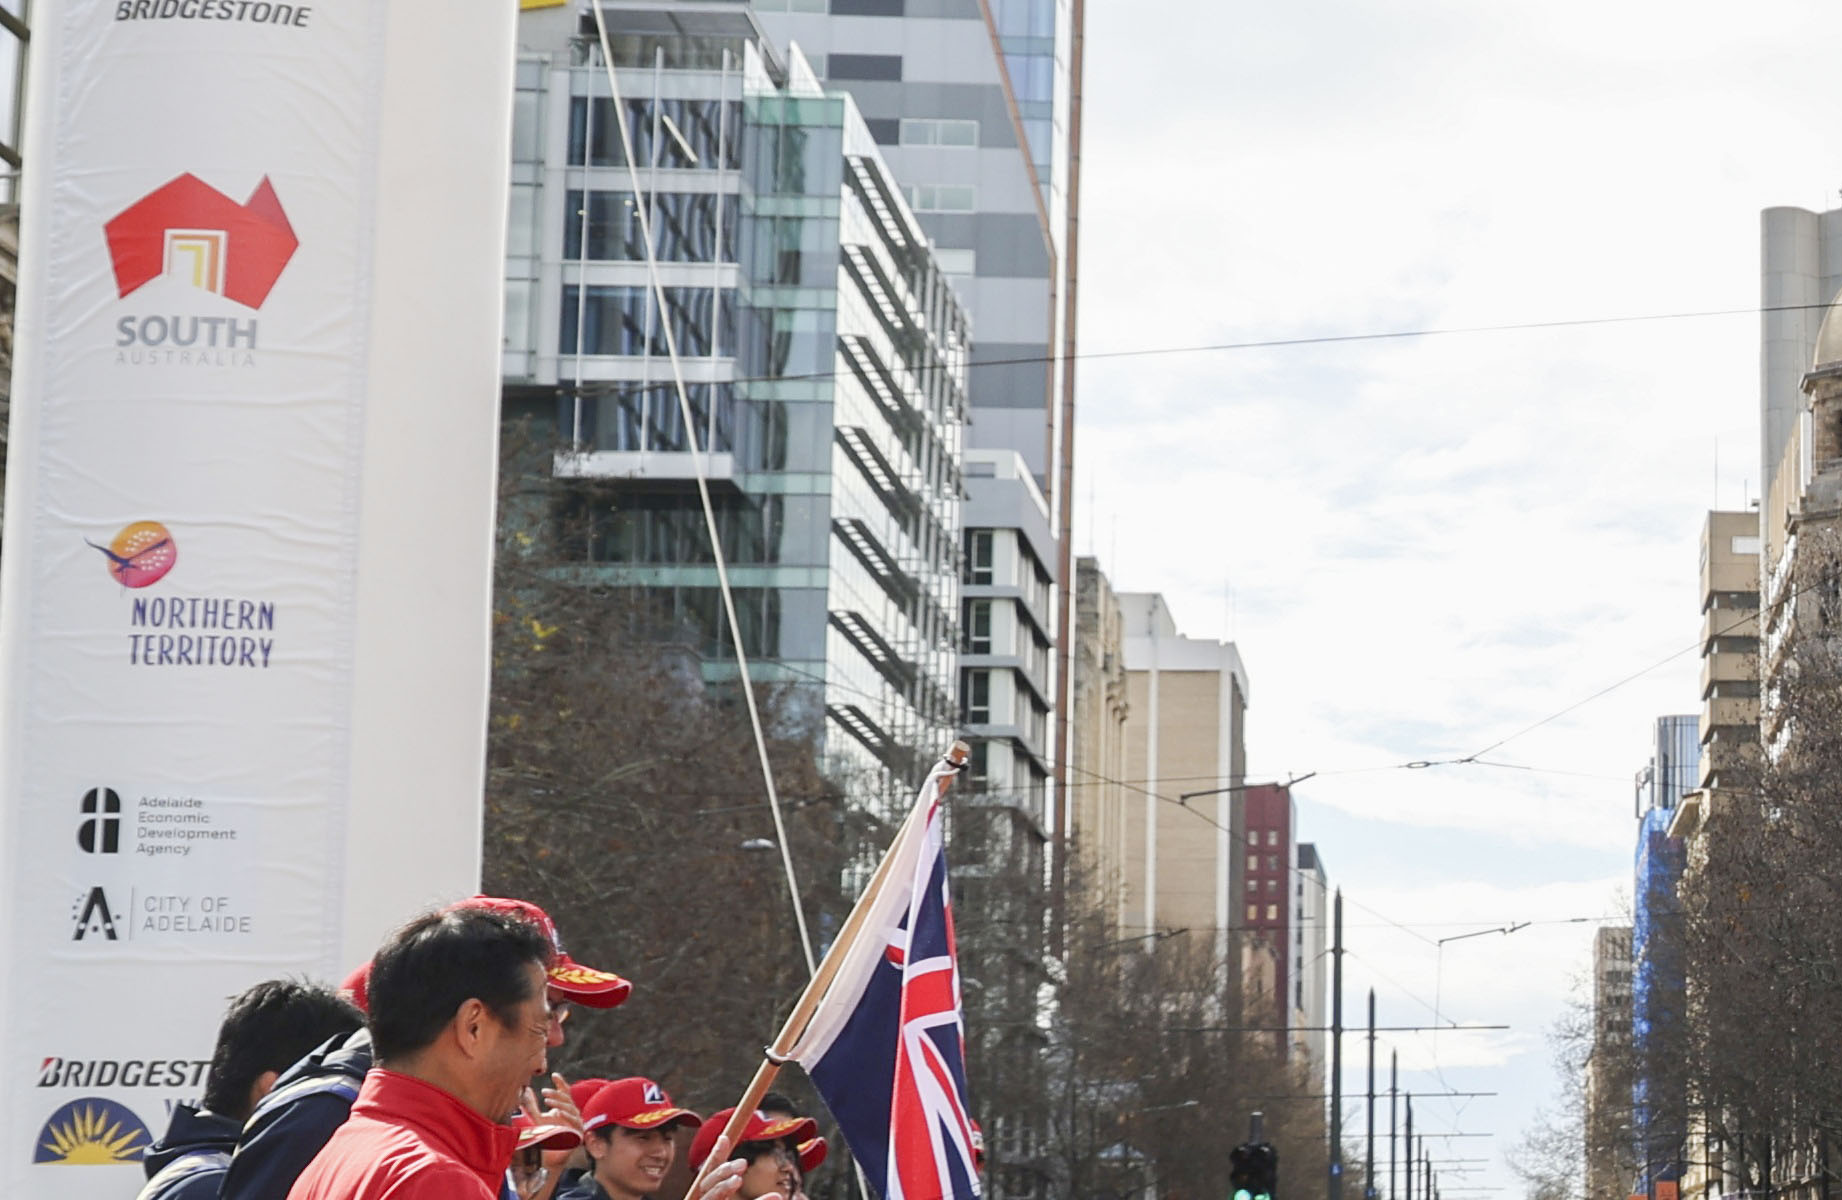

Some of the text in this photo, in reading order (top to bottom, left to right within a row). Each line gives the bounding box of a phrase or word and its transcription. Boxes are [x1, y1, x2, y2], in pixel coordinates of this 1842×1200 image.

[115, 0, 312, 27] BRIDGESTONE
[116, 315, 257, 349] SOUTH
[116, 351, 256, 366] AUSTRALIA
[131, 597, 274, 630] NORTHERN
[128, 634, 273, 668] TERRITORY
[138, 797, 203, 808] Adelaide
[138, 812, 211, 823] Economic
[137, 827, 238, 840] Development
[136, 843, 191, 856] Agency
[144, 896, 229, 912] CITY OF
[143, 916, 251, 932] ADELAIDE
